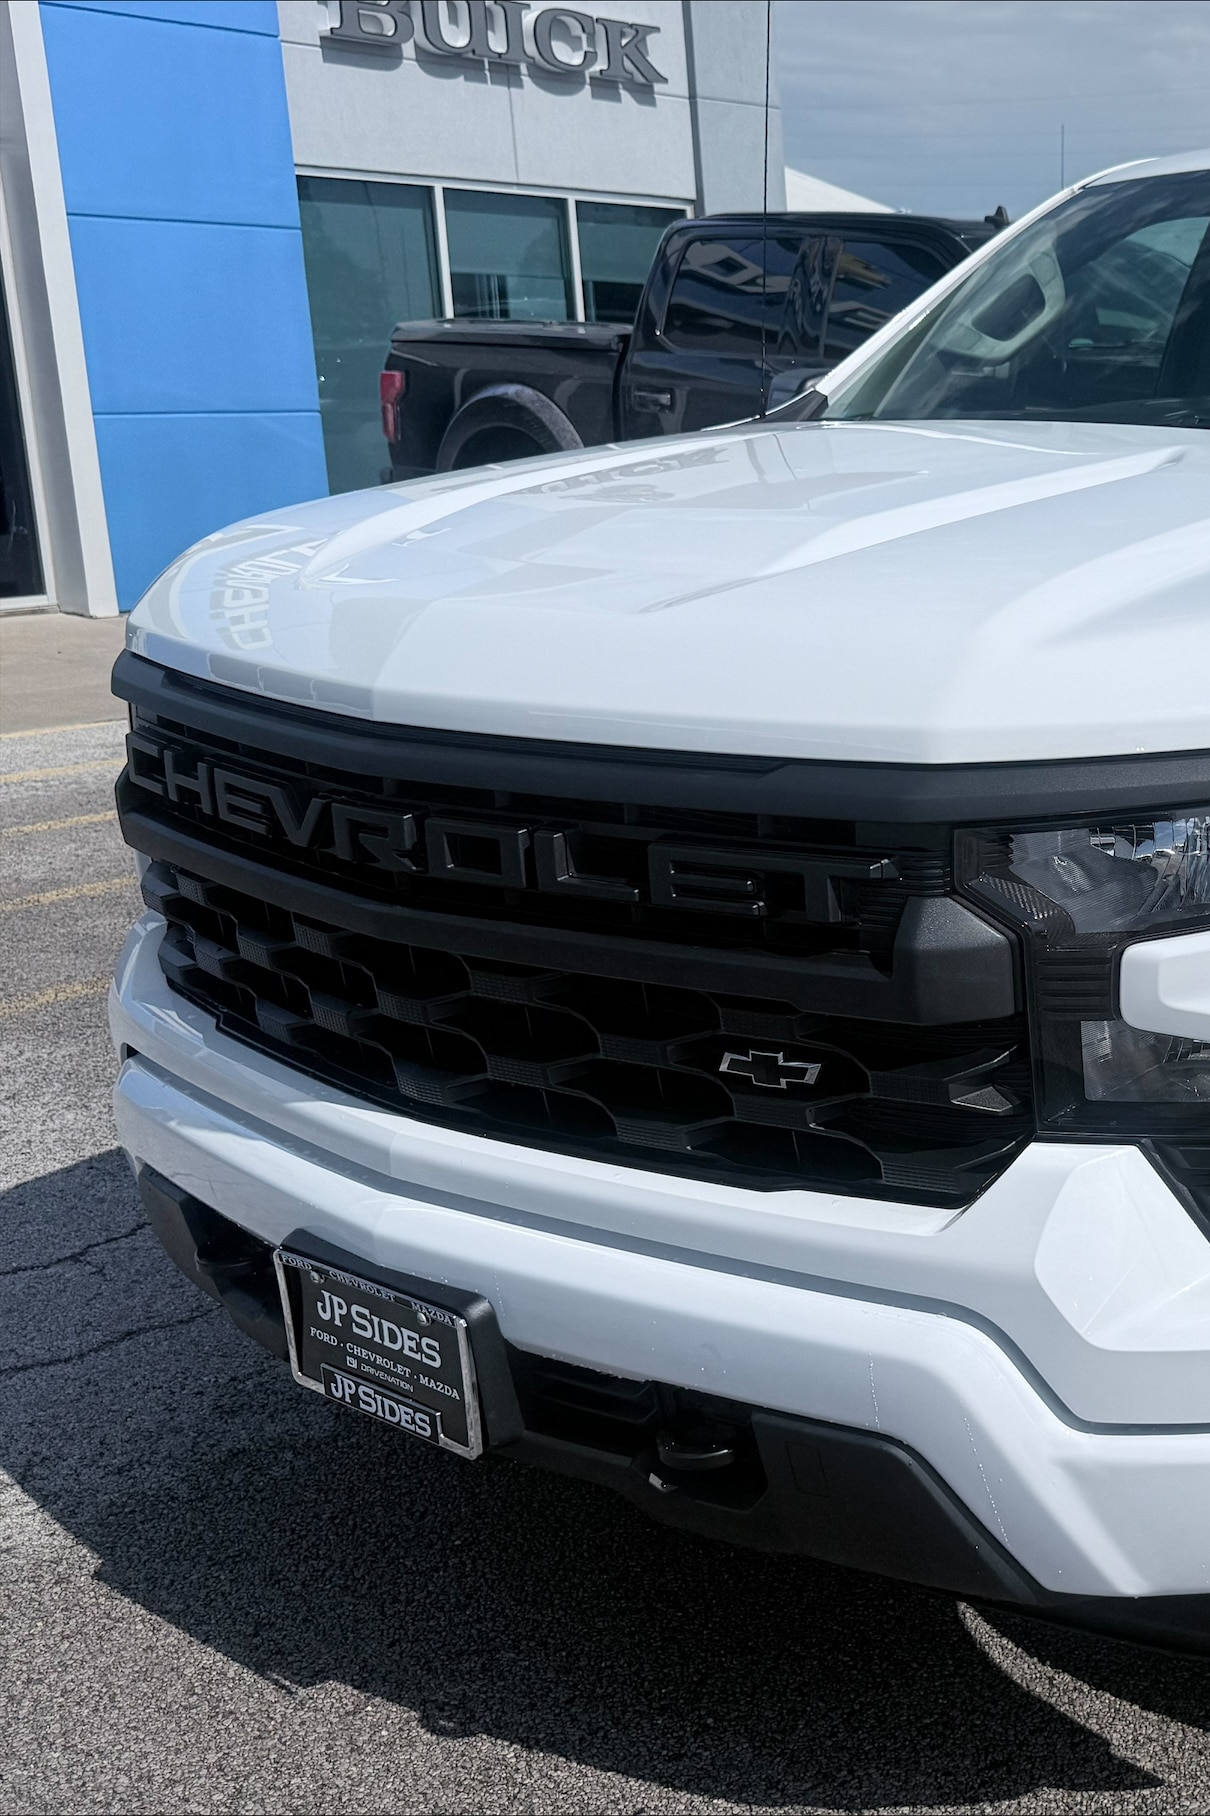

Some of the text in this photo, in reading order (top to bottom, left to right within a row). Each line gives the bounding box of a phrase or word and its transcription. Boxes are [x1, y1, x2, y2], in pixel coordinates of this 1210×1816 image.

[328, 0, 668, 85] BUICK
[126, 731, 901, 924] CHEVROLET
[281, 1254, 454, 1326] FORD CHEVROLET MAZDA
[310, 1327, 461, 1401] FORD CHEVROLET MAZDA
[317, 1290, 442, 1368] JP SIDES
[330, 1373, 432, 1438] JP SIDES
